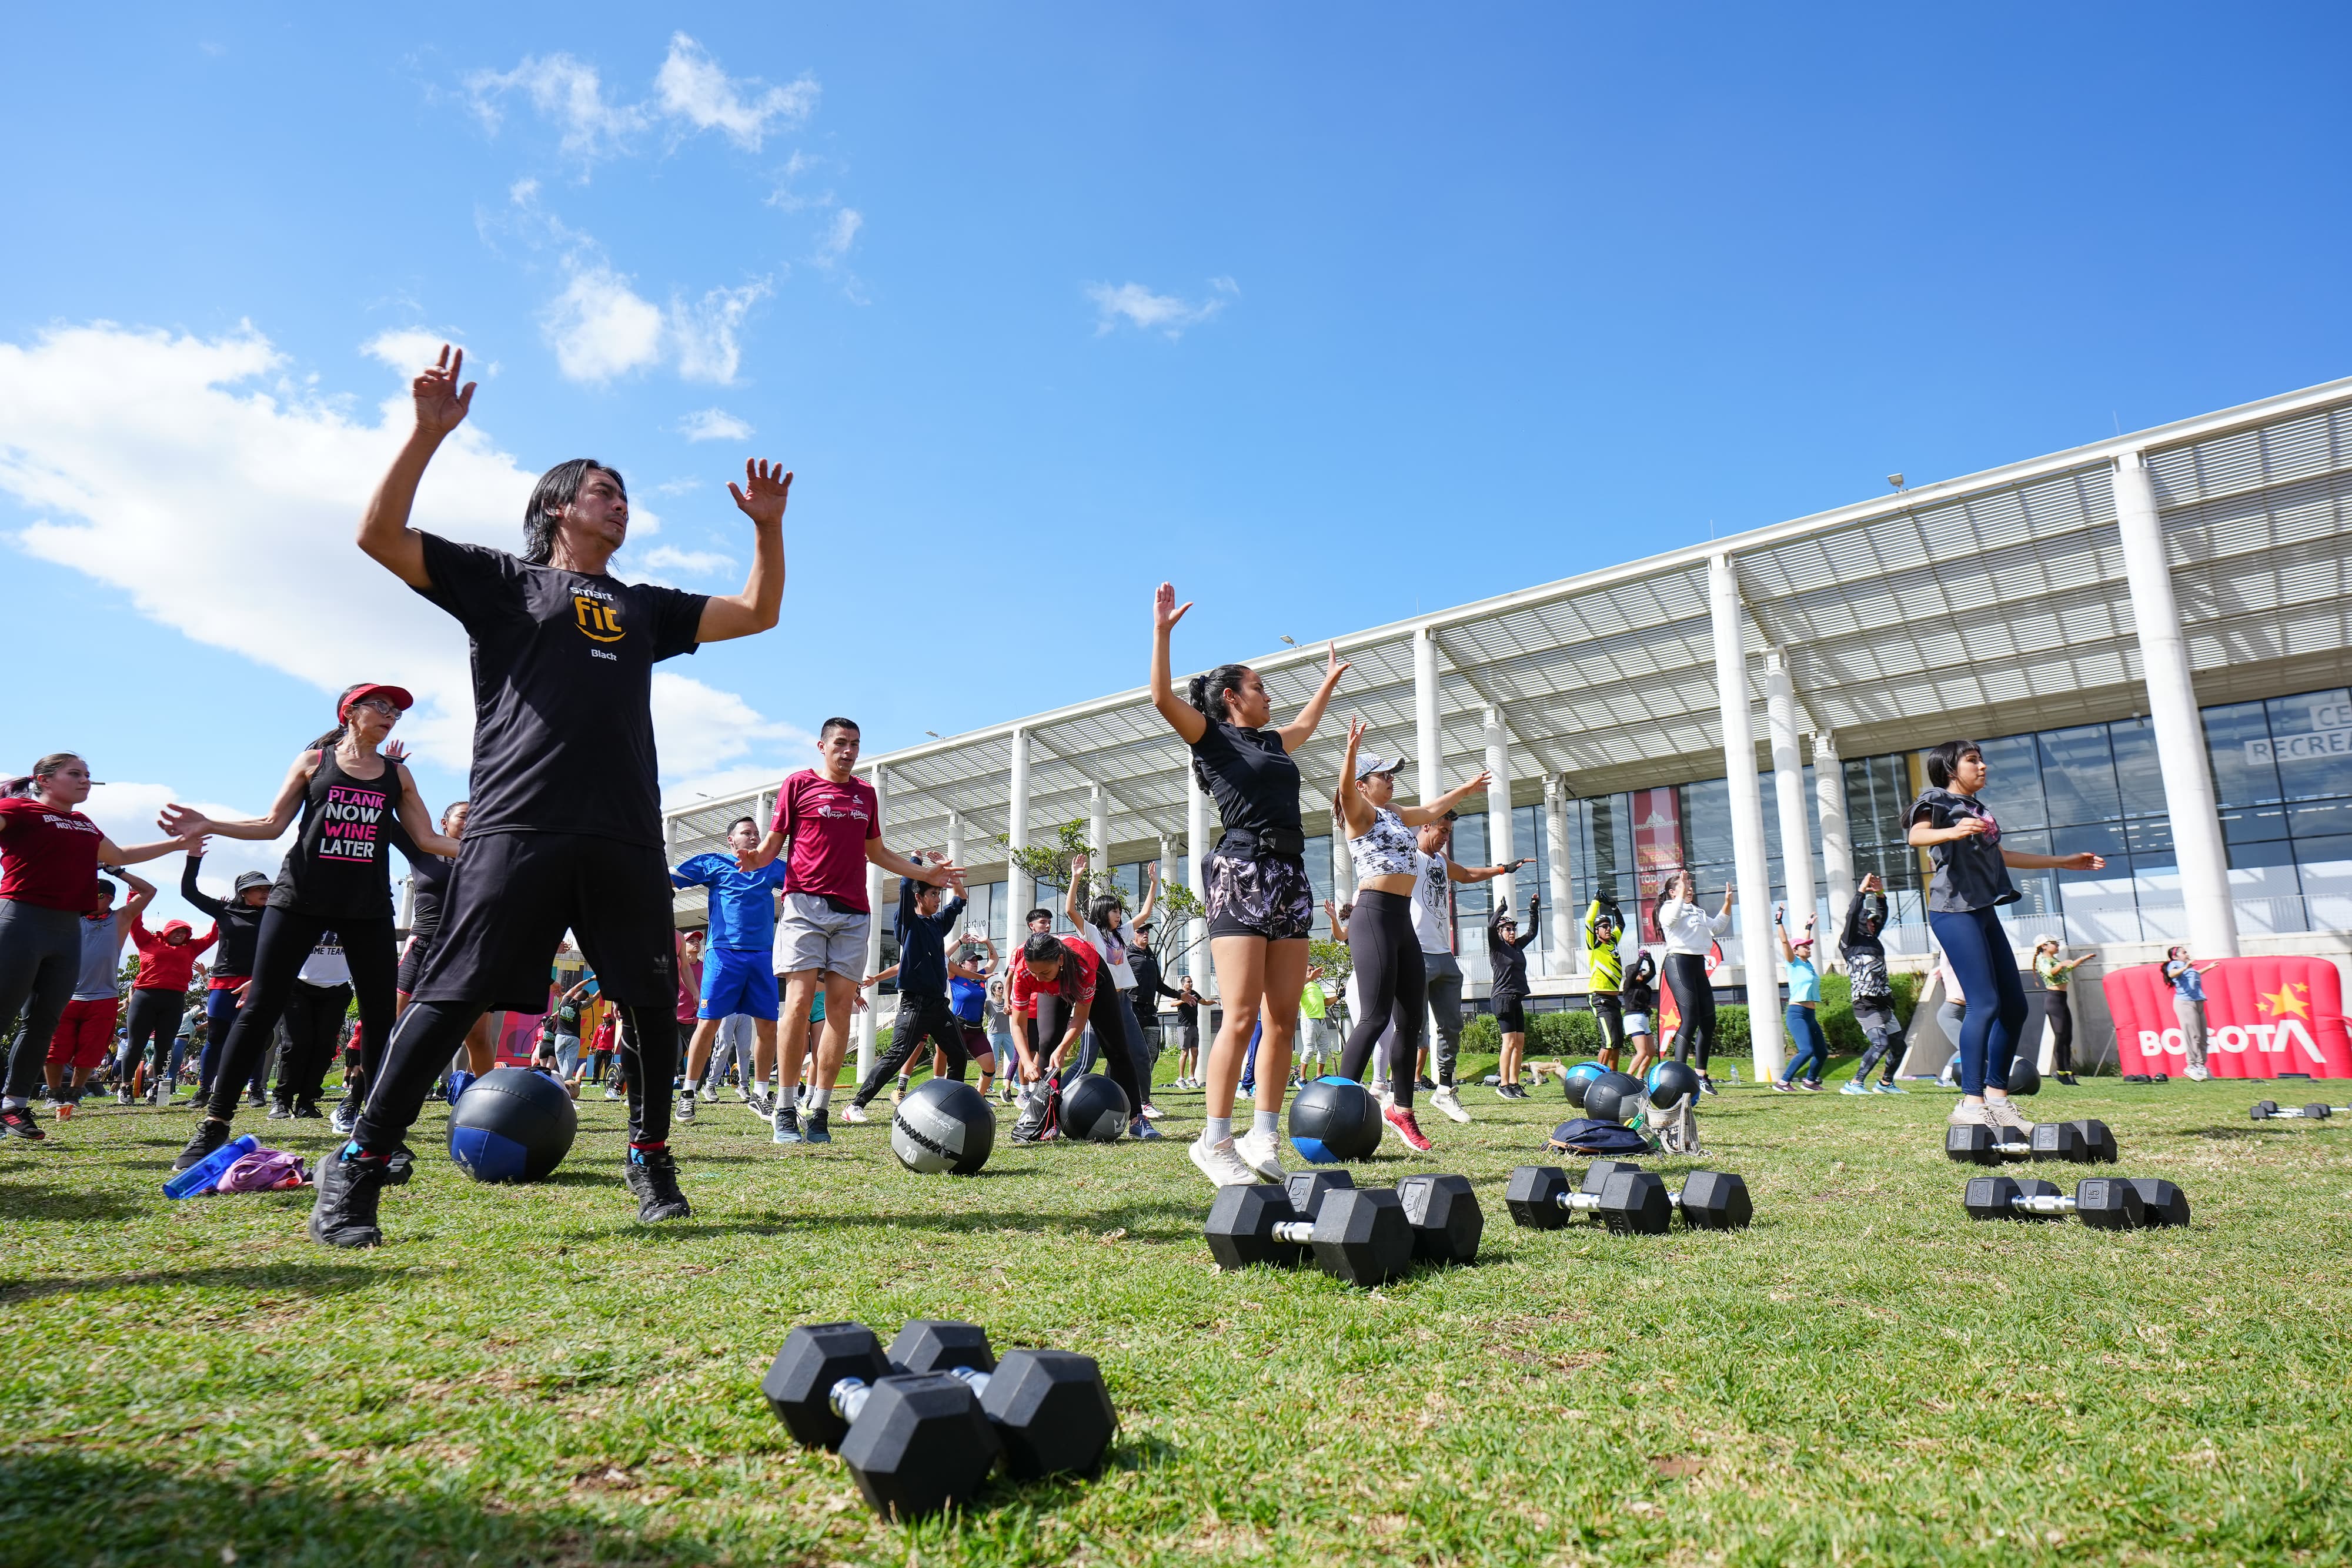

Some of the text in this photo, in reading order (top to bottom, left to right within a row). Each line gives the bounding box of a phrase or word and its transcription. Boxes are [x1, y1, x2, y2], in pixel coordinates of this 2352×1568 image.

[570, 587, 613, 600] smart
[574, 596, 622, 632] fit
[591, 648, 617, 661] Black
[2252, 730, 2352, 760] RECRE
[328, 789, 385, 809] PLANK
[325, 803, 382, 823] NOW
[324, 820, 377, 840] WINE
[1231, 831, 1253, 840] adidas
[319, 838, 375, 857] LATER
[1640, 874, 1663, 884] TODO
[964, 919, 986, 931] portvo
[2040, 1132, 2053, 1144] 50
[904, 1145, 918, 1165] 20
[1290, 1186, 1307, 1206] 50
[2087, 1189, 2100, 1201] 15
